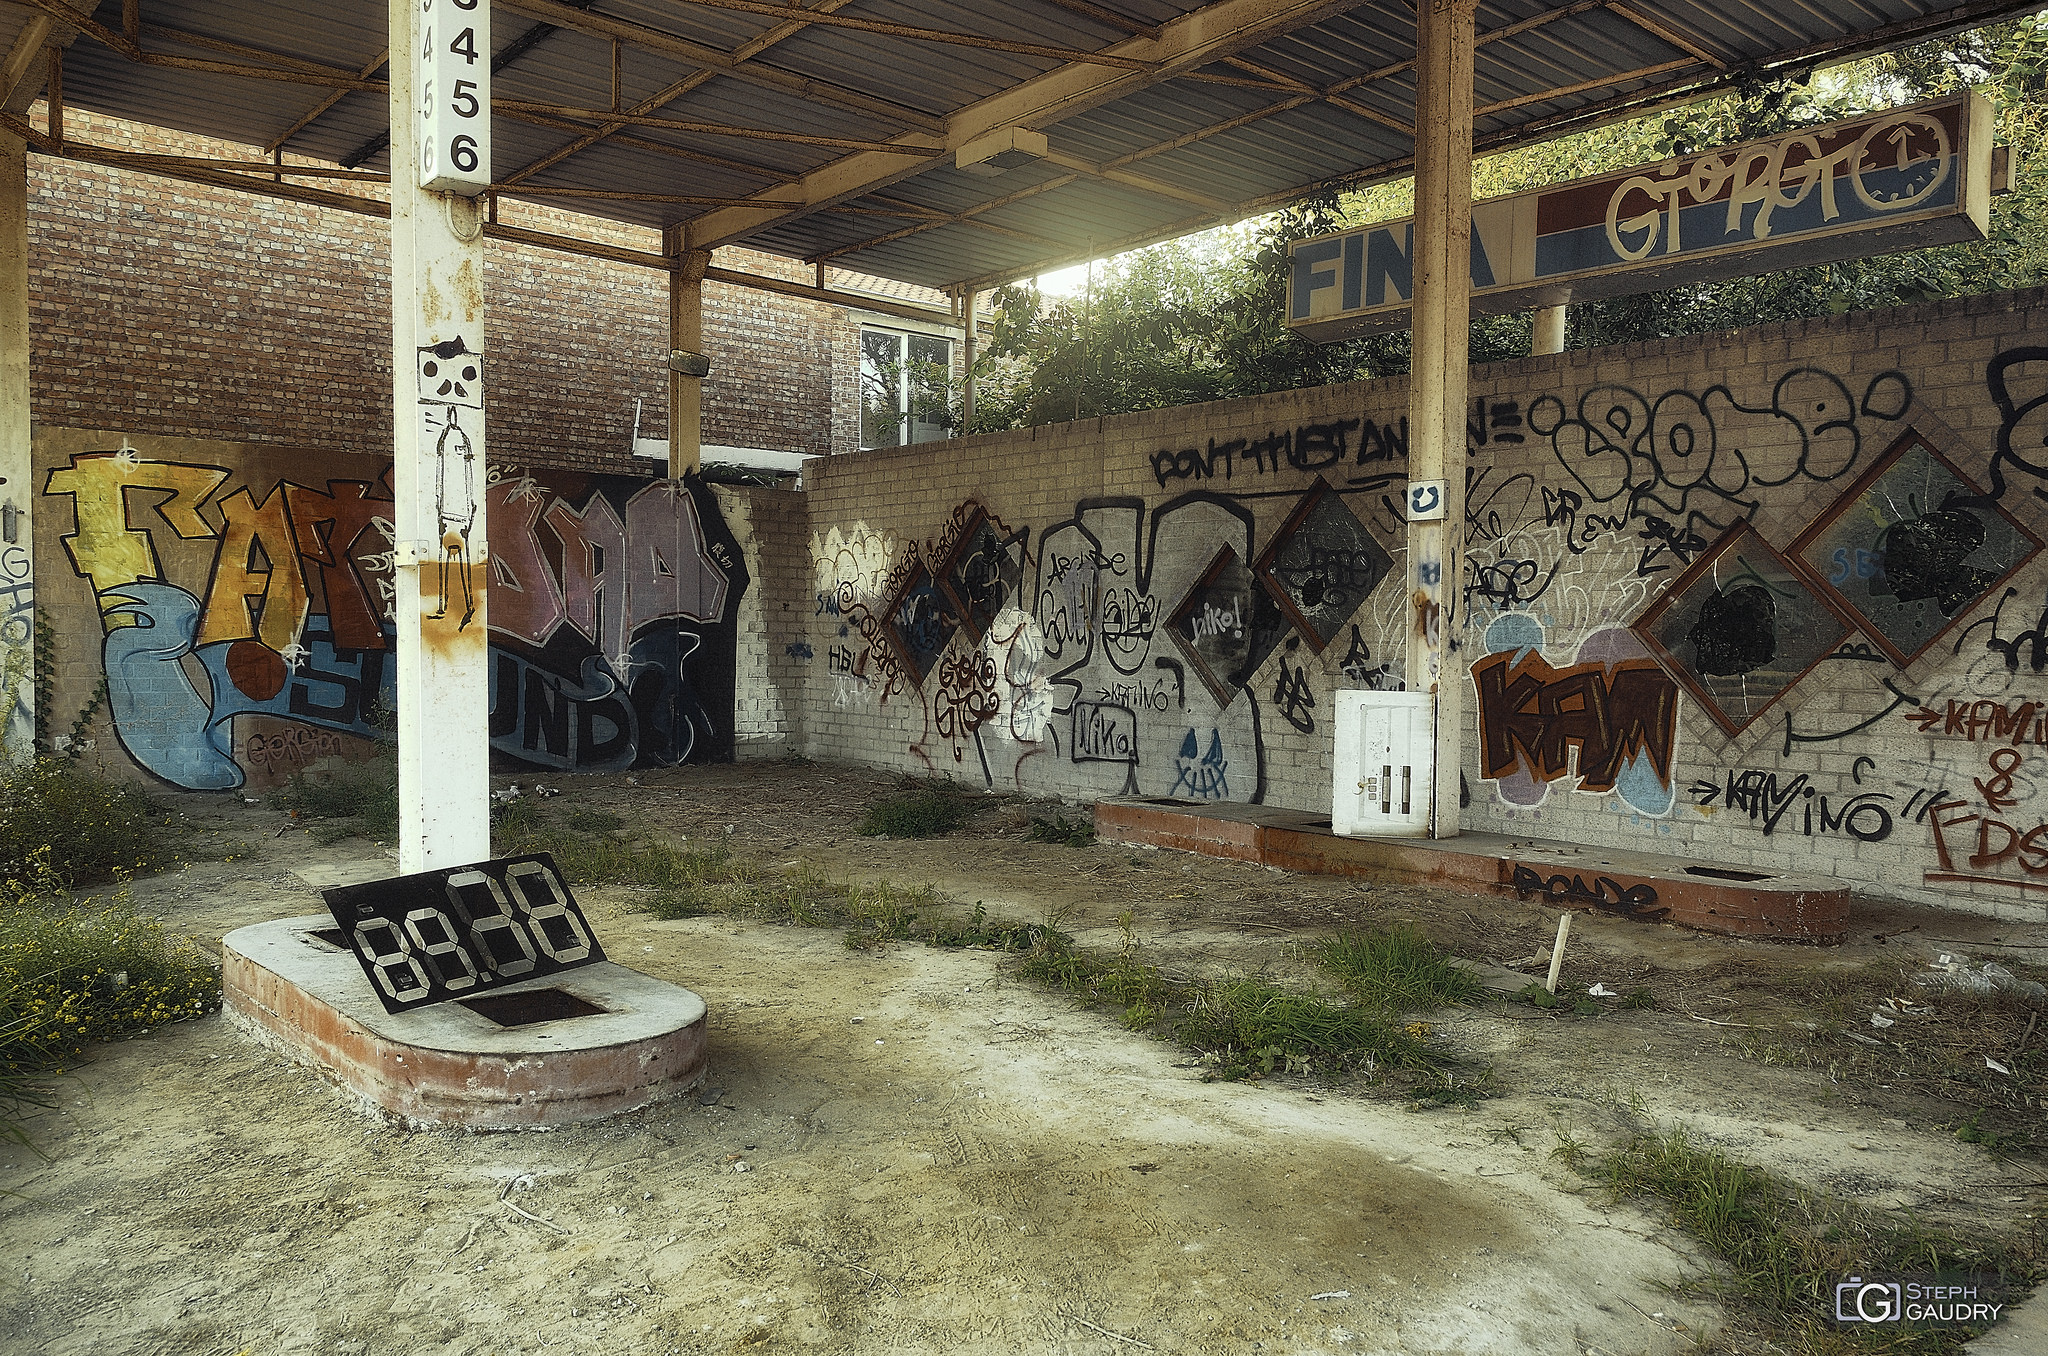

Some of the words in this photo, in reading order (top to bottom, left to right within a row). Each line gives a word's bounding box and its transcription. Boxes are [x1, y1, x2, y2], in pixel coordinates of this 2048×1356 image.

[450, 27, 479, 65] 4
[451, 79, 479, 118] 5
[450, 134, 479, 172] 6
